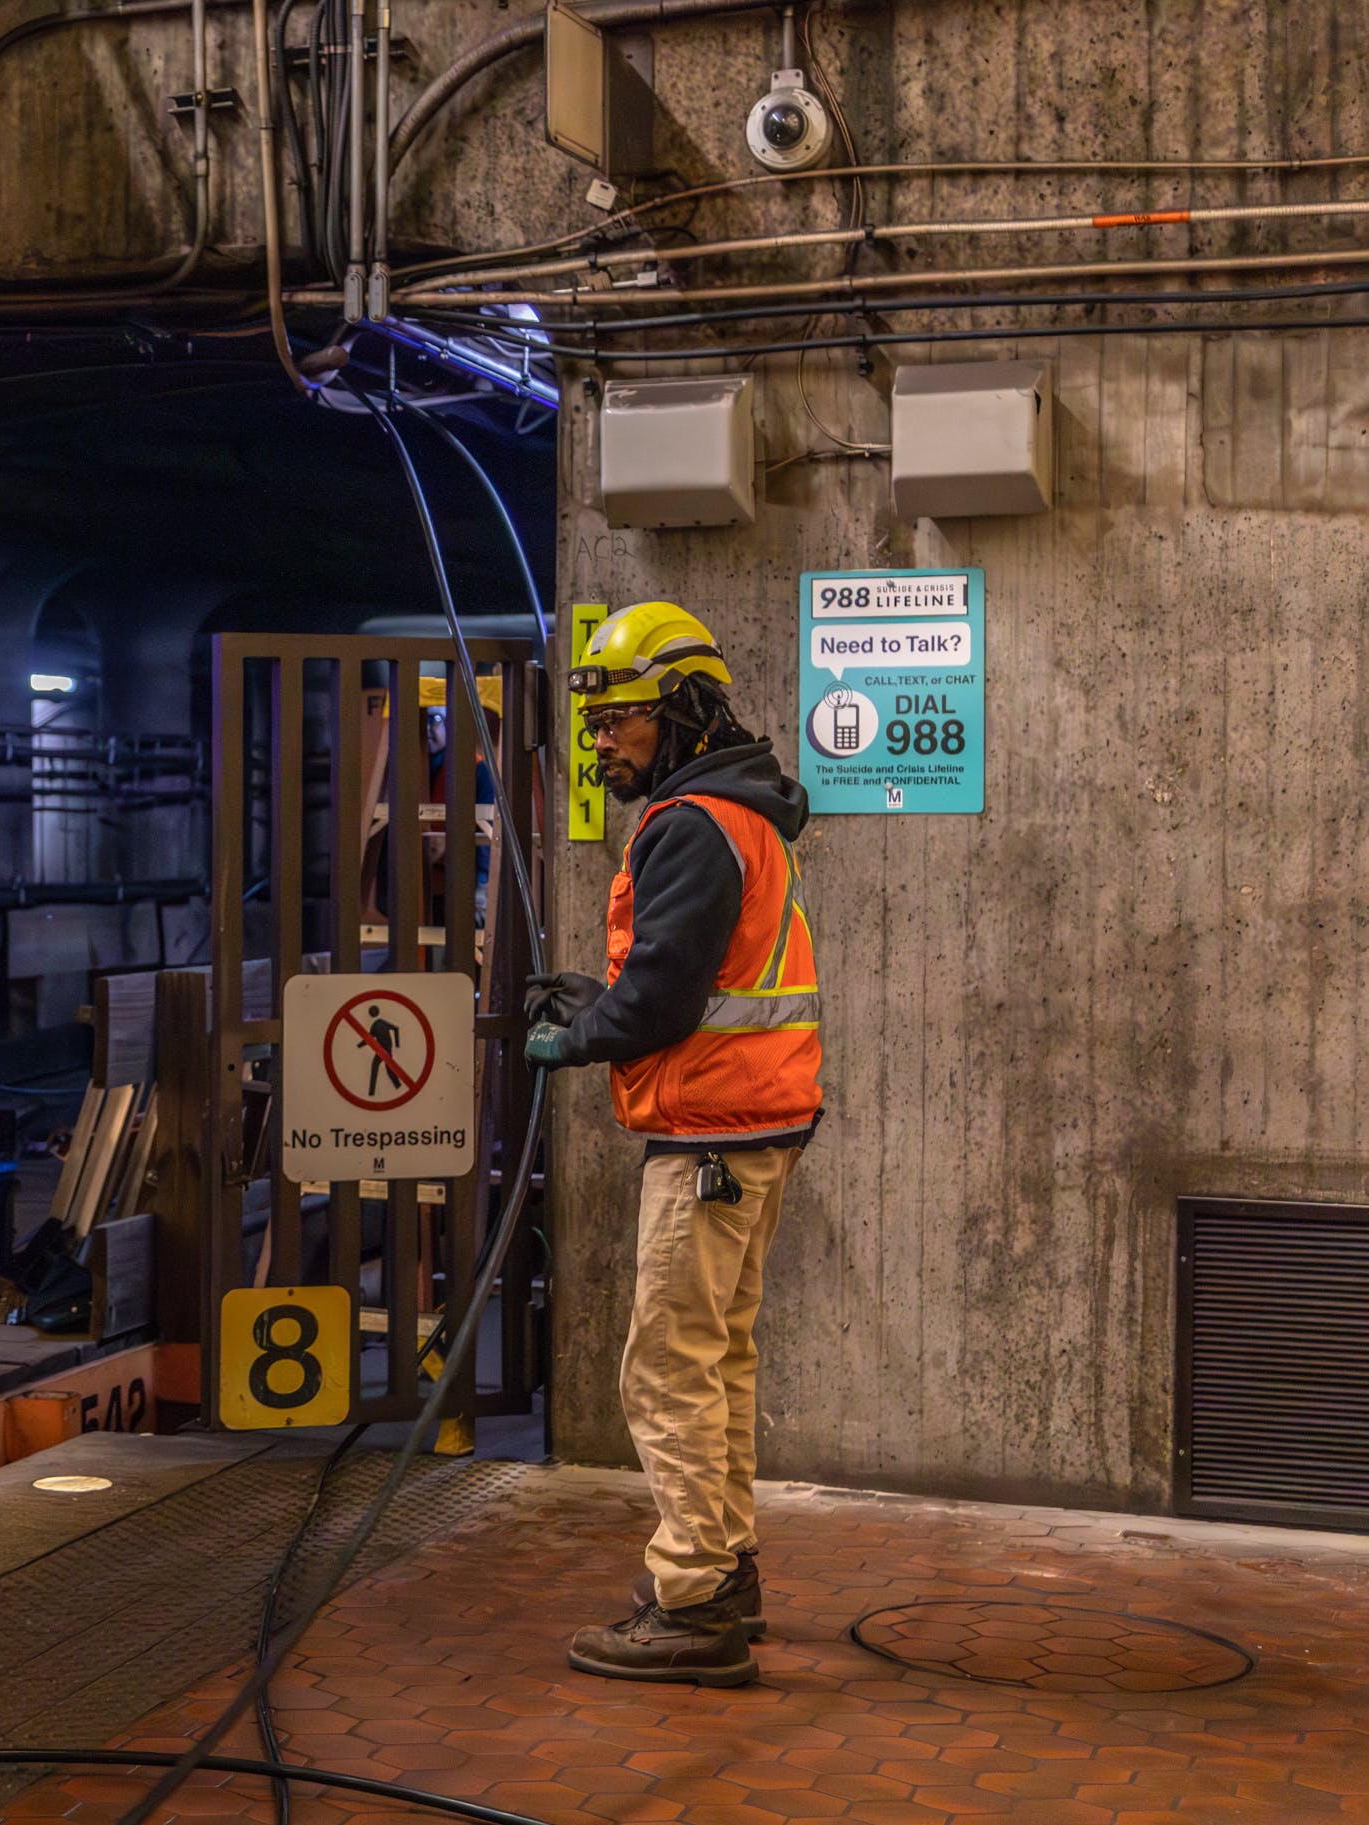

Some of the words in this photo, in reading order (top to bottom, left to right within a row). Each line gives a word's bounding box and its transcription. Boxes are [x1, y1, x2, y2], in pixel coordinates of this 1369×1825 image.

[821, 587, 870, 609] 988
[877, 585, 912, 593] SUICIDE
[876, 594, 955, 607] LIFELINE
[821, 636, 873, 654] Need
[881, 637, 901, 653] to
[906, 634, 962, 652] Talk?
[945, 674, 976, 684] CHAT
[577, 619, 599, 787] TCK
[895, 694, 956, 714] DIAL
[886, 719, 966, 755] 988
[815, 765, 833, 774] The
[836, 765, 873, 774] Suicide
[876, 765, 894, 773] and
[896, 764, 925, 773] Crisis
[928, 764, 964, 773] Lifeline
[821, 777, 830, 785] is
[833, 777, 860, 785] FREE
[863, 777, 881, 785] and
[884, 776, 961, 785] CONFIDENTIAL
[579, 799, 590, 823] 1
[291, 1129, 321, 1149] No
[330, 1126, 466, 1150] Trespassing
[249, 1304, 323, 1409] 8
